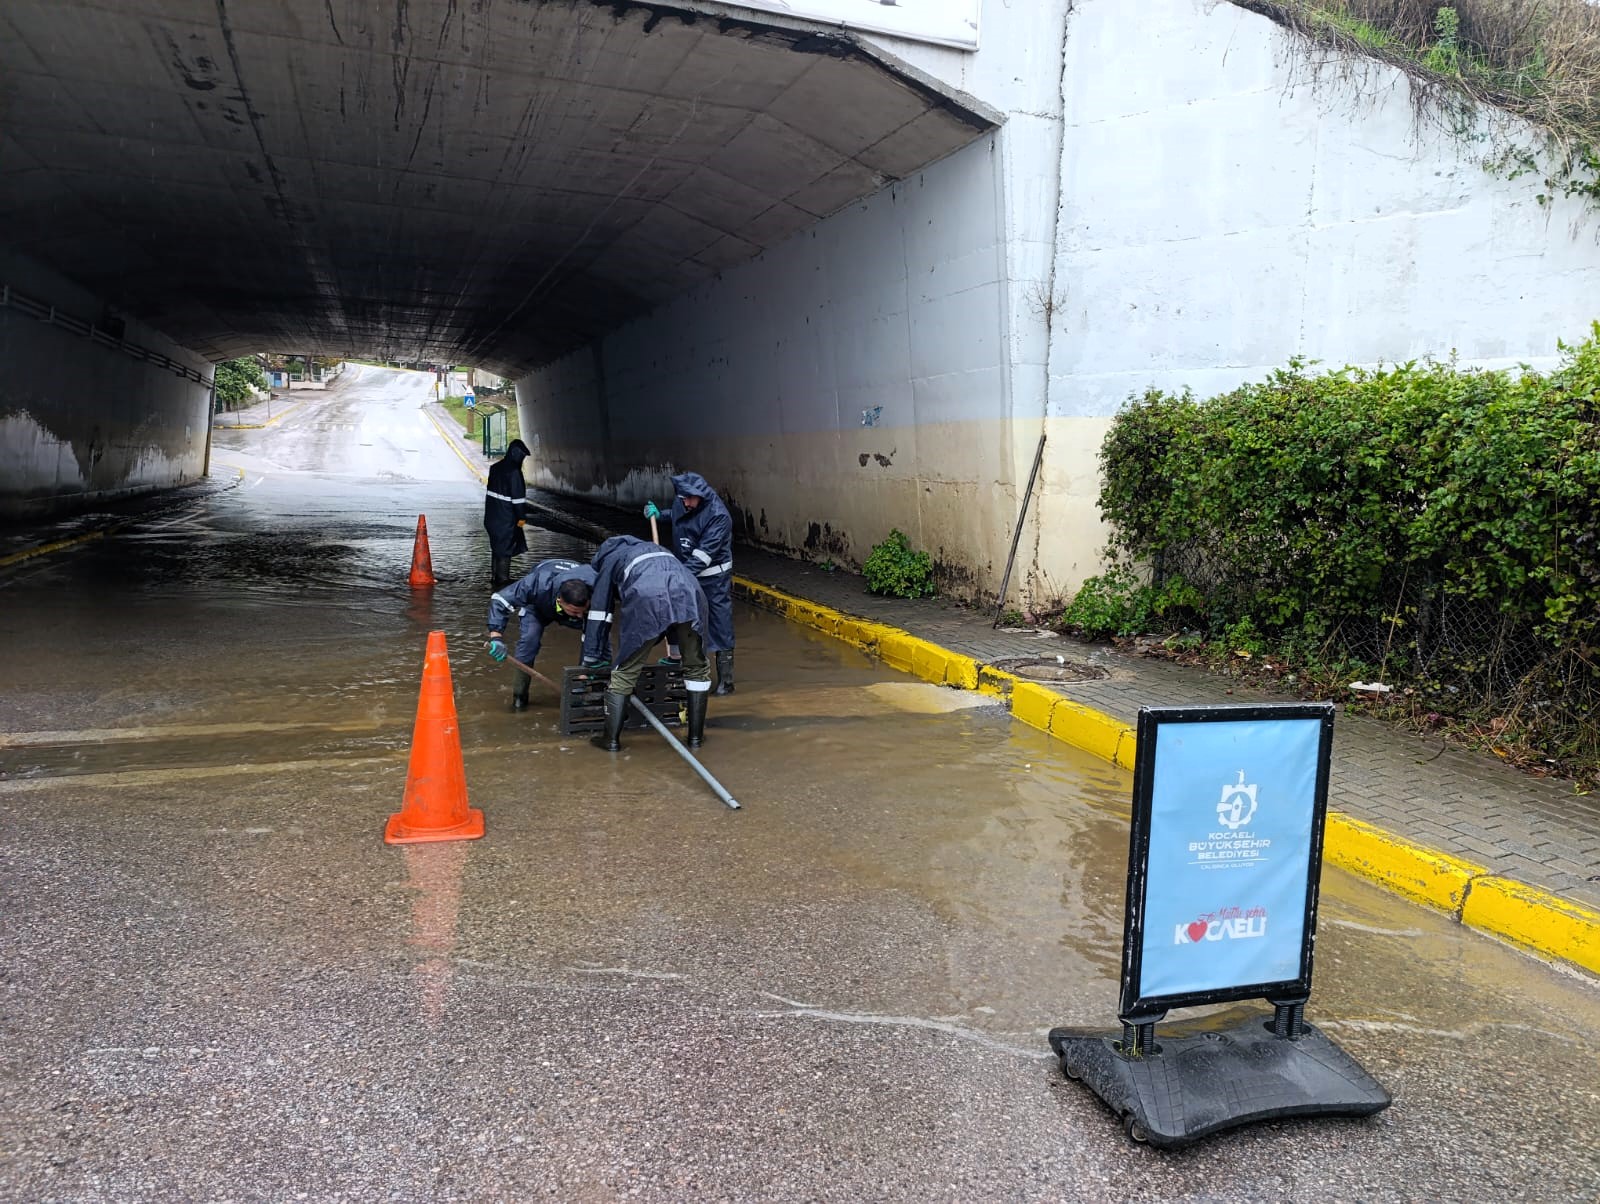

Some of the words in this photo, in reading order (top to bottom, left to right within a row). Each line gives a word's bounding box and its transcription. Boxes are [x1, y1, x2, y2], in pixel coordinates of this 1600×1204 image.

[1208, 832, 1255, 840] KOCAELİ
[1189, 839, 1271, 851] BÜYÜKŞEHİR
[1198, 850, 1260, 859] BELEDİYESİ
